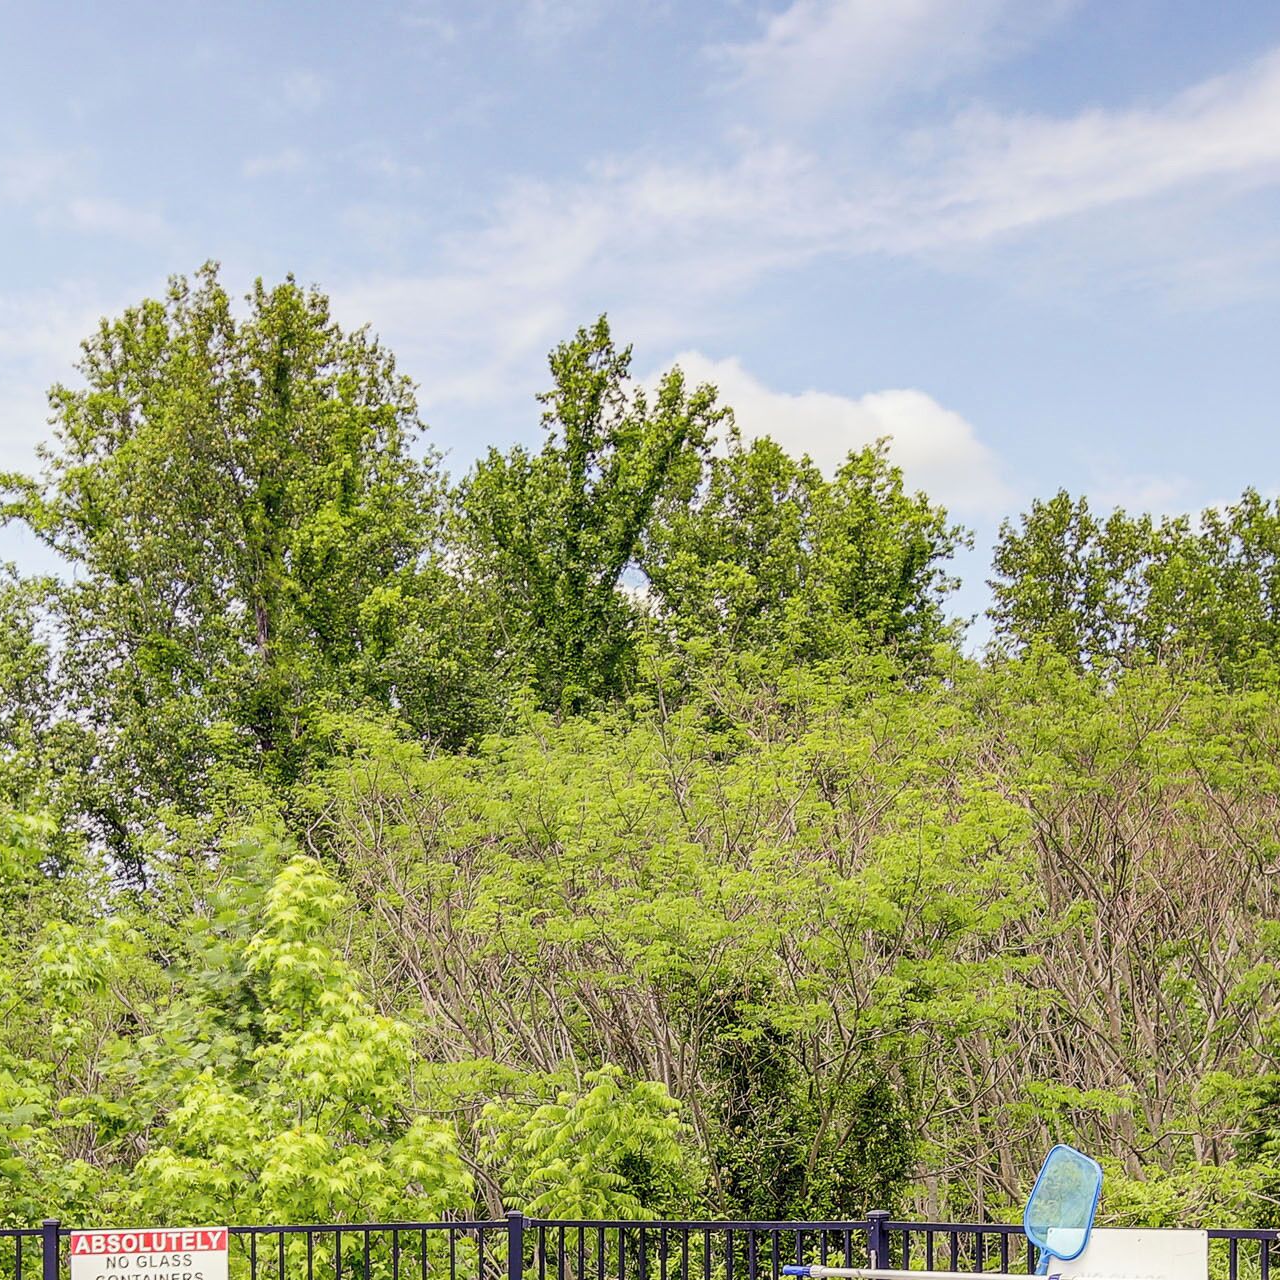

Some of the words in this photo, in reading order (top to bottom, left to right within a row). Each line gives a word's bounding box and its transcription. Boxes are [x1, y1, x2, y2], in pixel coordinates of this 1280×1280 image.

[75, 1231, 222, 1254] ABSOLUTELY
[106, 1256, 130, 1269] NO
[136, 1253, 193, 1268] GLASS
